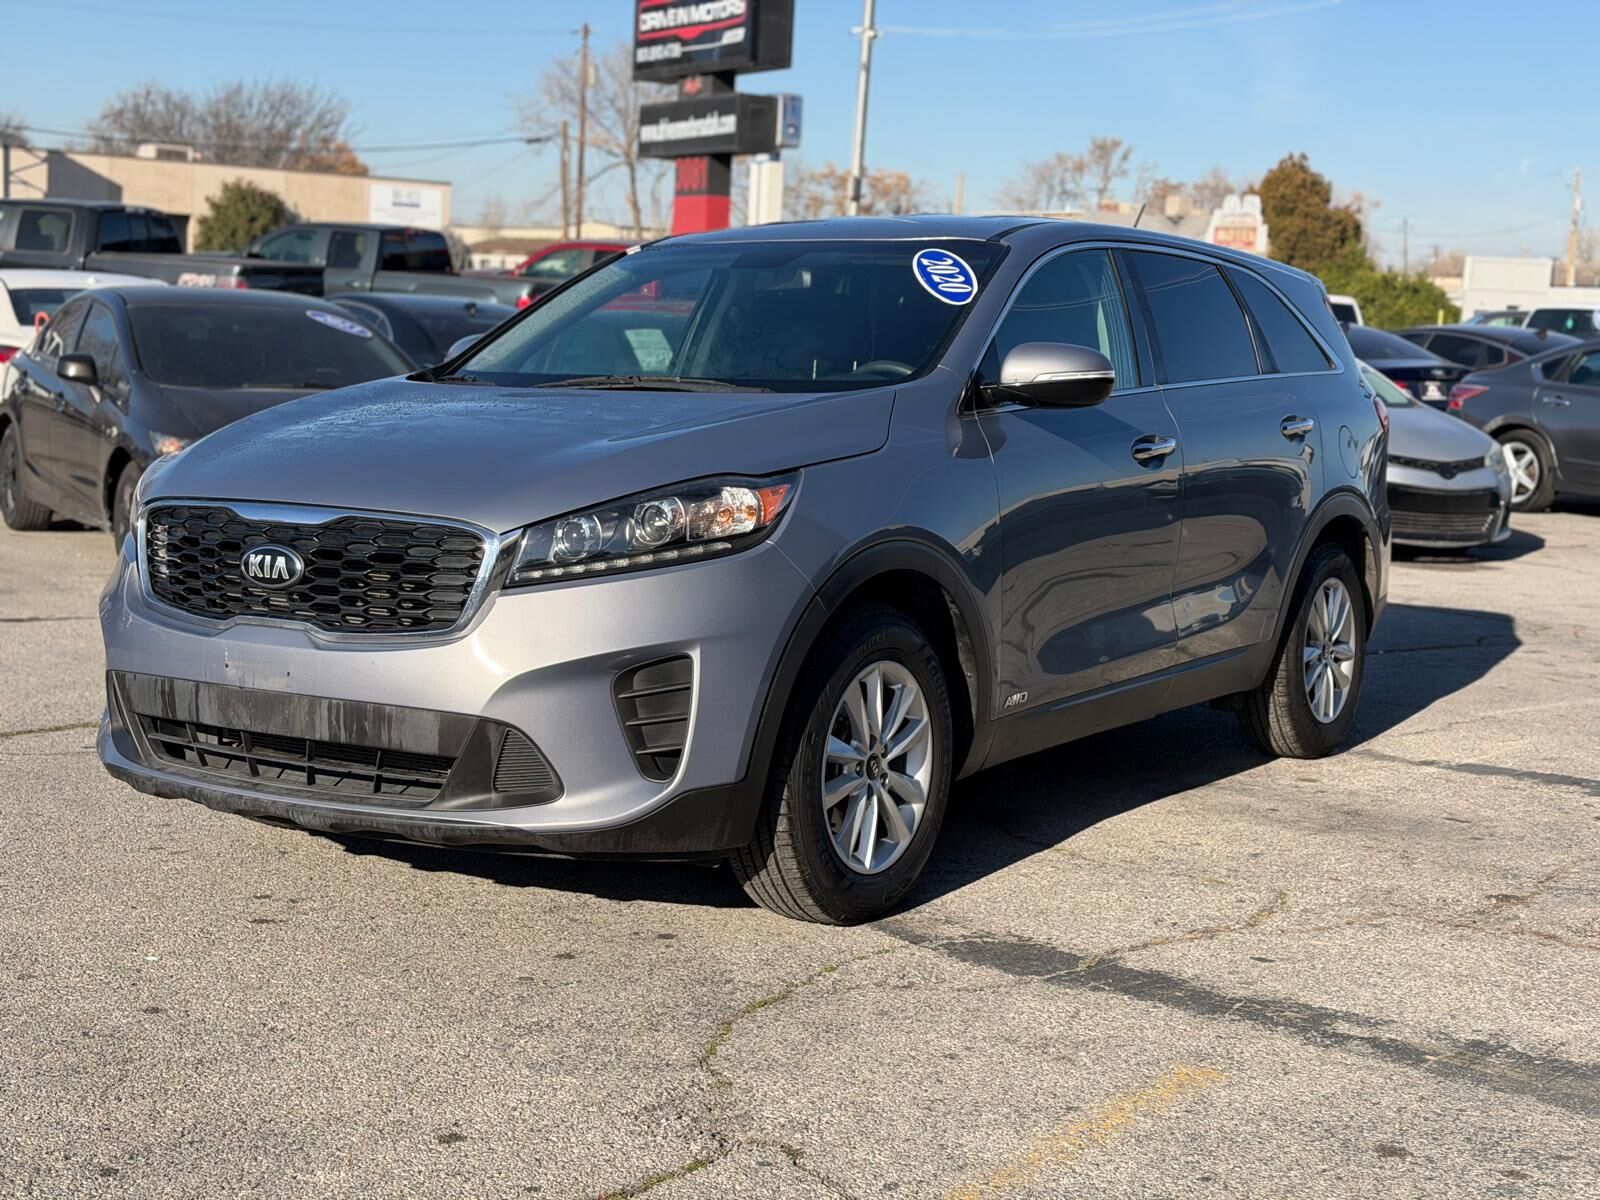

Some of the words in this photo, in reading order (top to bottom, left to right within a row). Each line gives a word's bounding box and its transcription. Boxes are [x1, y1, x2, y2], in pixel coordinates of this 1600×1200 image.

[920, 257, 972, 293] 2020
[248, 553, 290, 580] KIA
[1003, 691, 1028, 709] AWD
